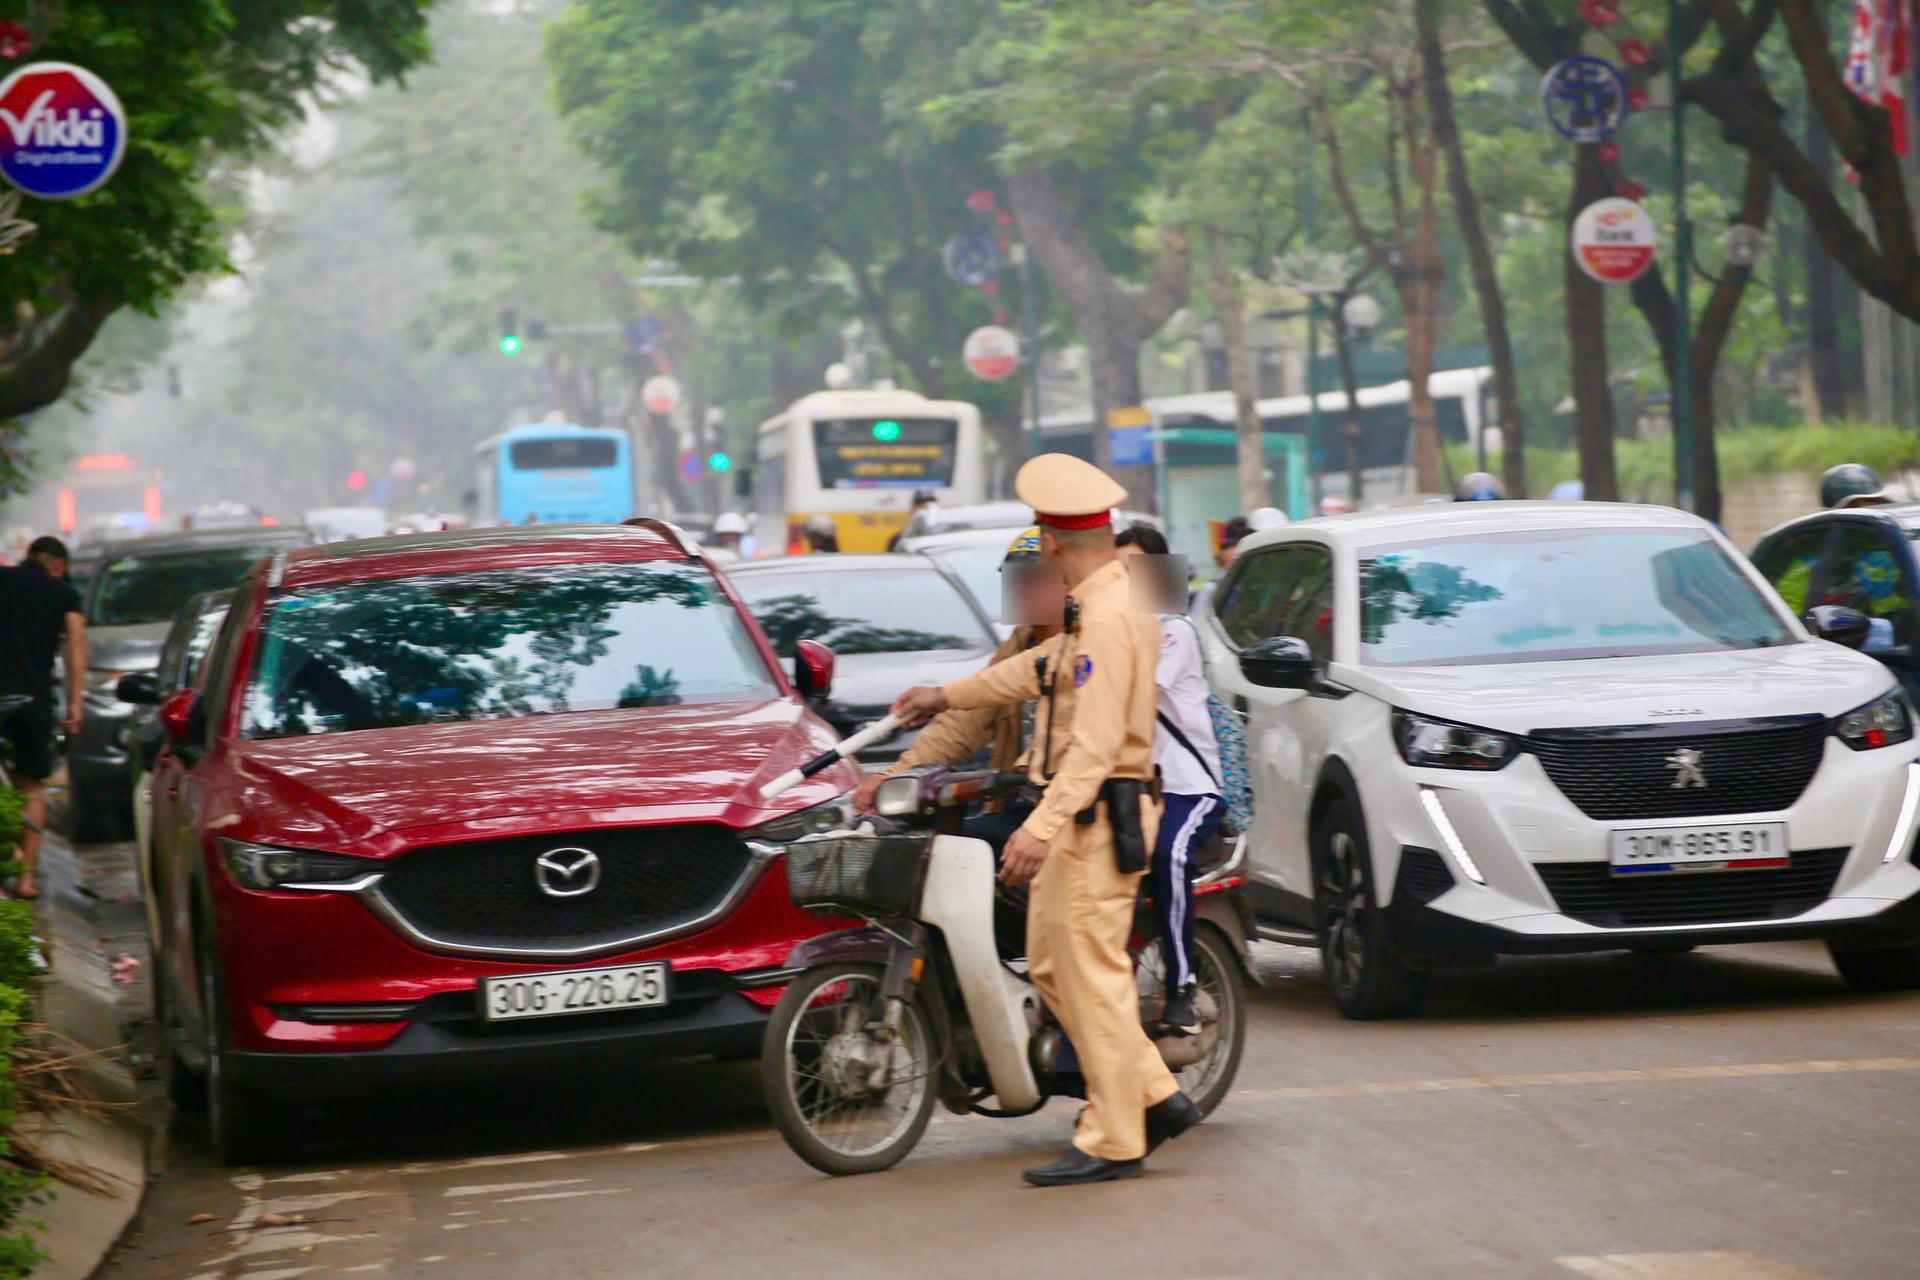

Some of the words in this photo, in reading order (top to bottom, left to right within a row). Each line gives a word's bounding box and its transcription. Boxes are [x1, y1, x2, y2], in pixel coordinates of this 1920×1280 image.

[0, 89, 104, 147] Vikki
[1627, 830, 1769, 858] 30M-865.91
[494, 969, 659, 1014] 30G-226.25
